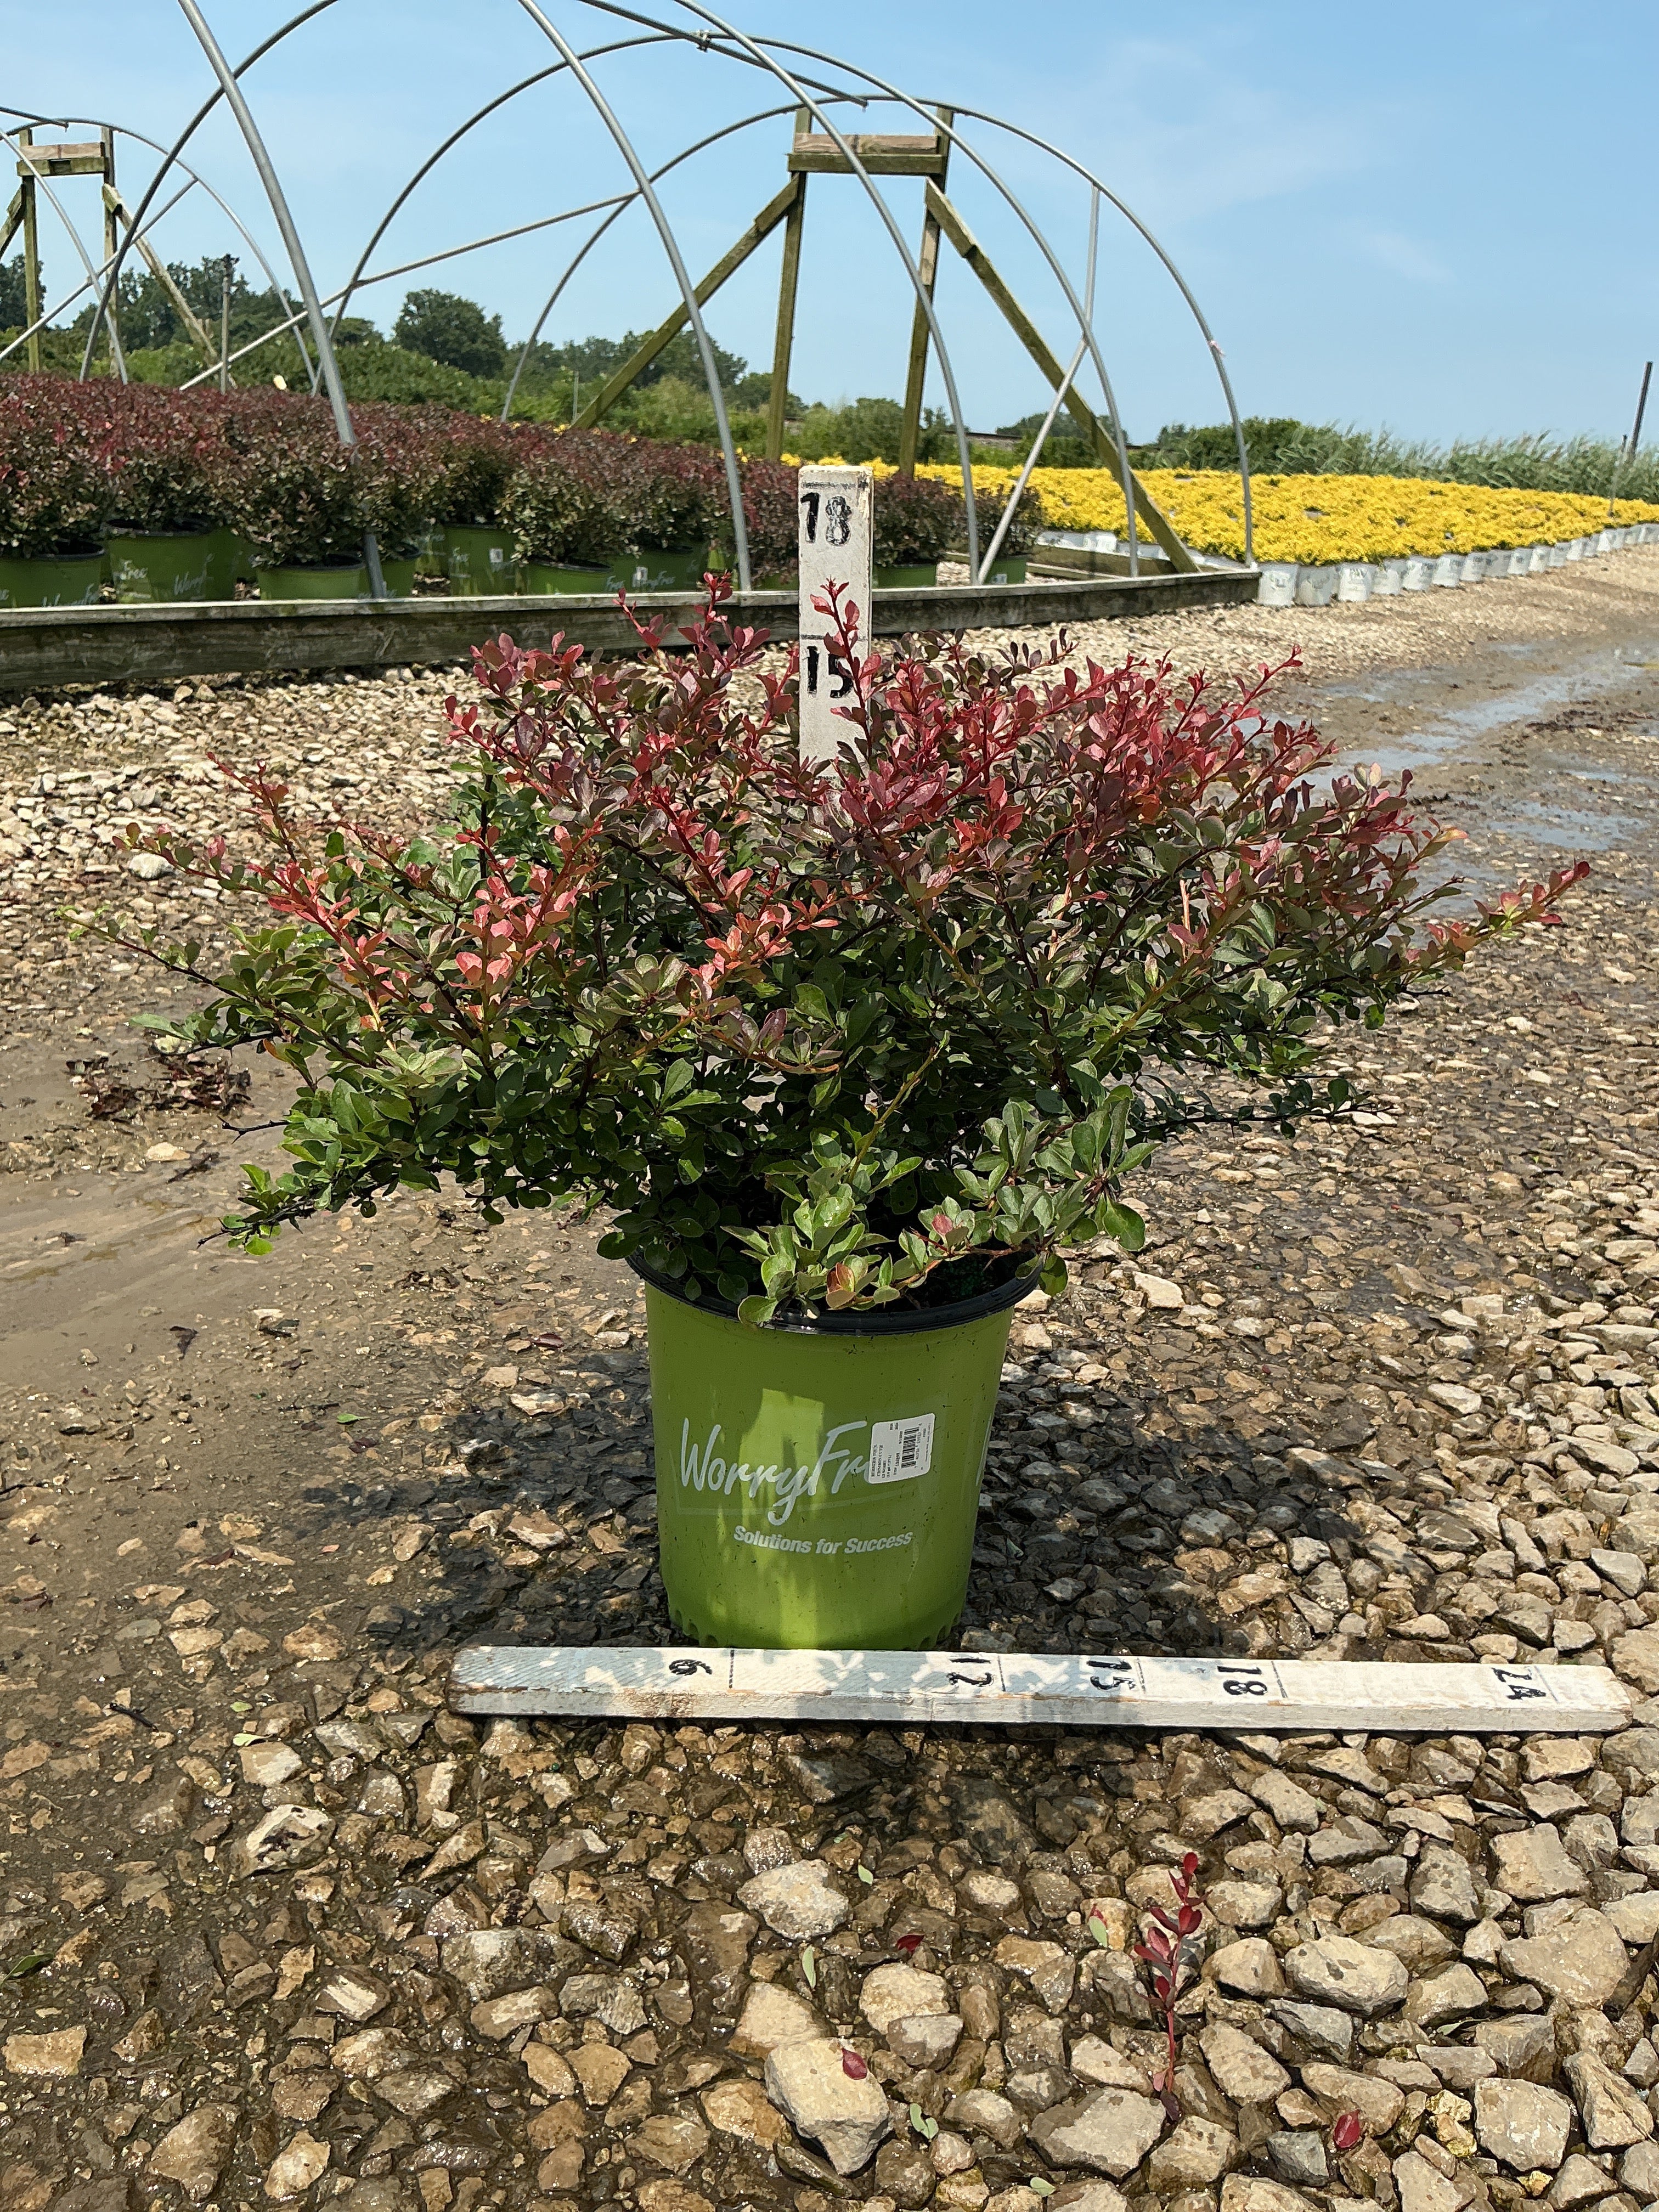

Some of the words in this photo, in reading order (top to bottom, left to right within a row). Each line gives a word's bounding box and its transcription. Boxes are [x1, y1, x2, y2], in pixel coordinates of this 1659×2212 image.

[800, 492, 853, 546] 18
[806, 646, 854, 699] 15
[733, 1525, 812, 1553] Solutions
[815, 1538, 843, 1554] for
[844, 1531, 913, 1554] Success
[669, 1659, 713, 1676] 6
[946, 1658, 994, 1688] 12
[1086, 1660, 1136, 1690] 15
[1217, 1666, 1268, 1696] 18
[1491, 1666, 1547, 1700] 24
